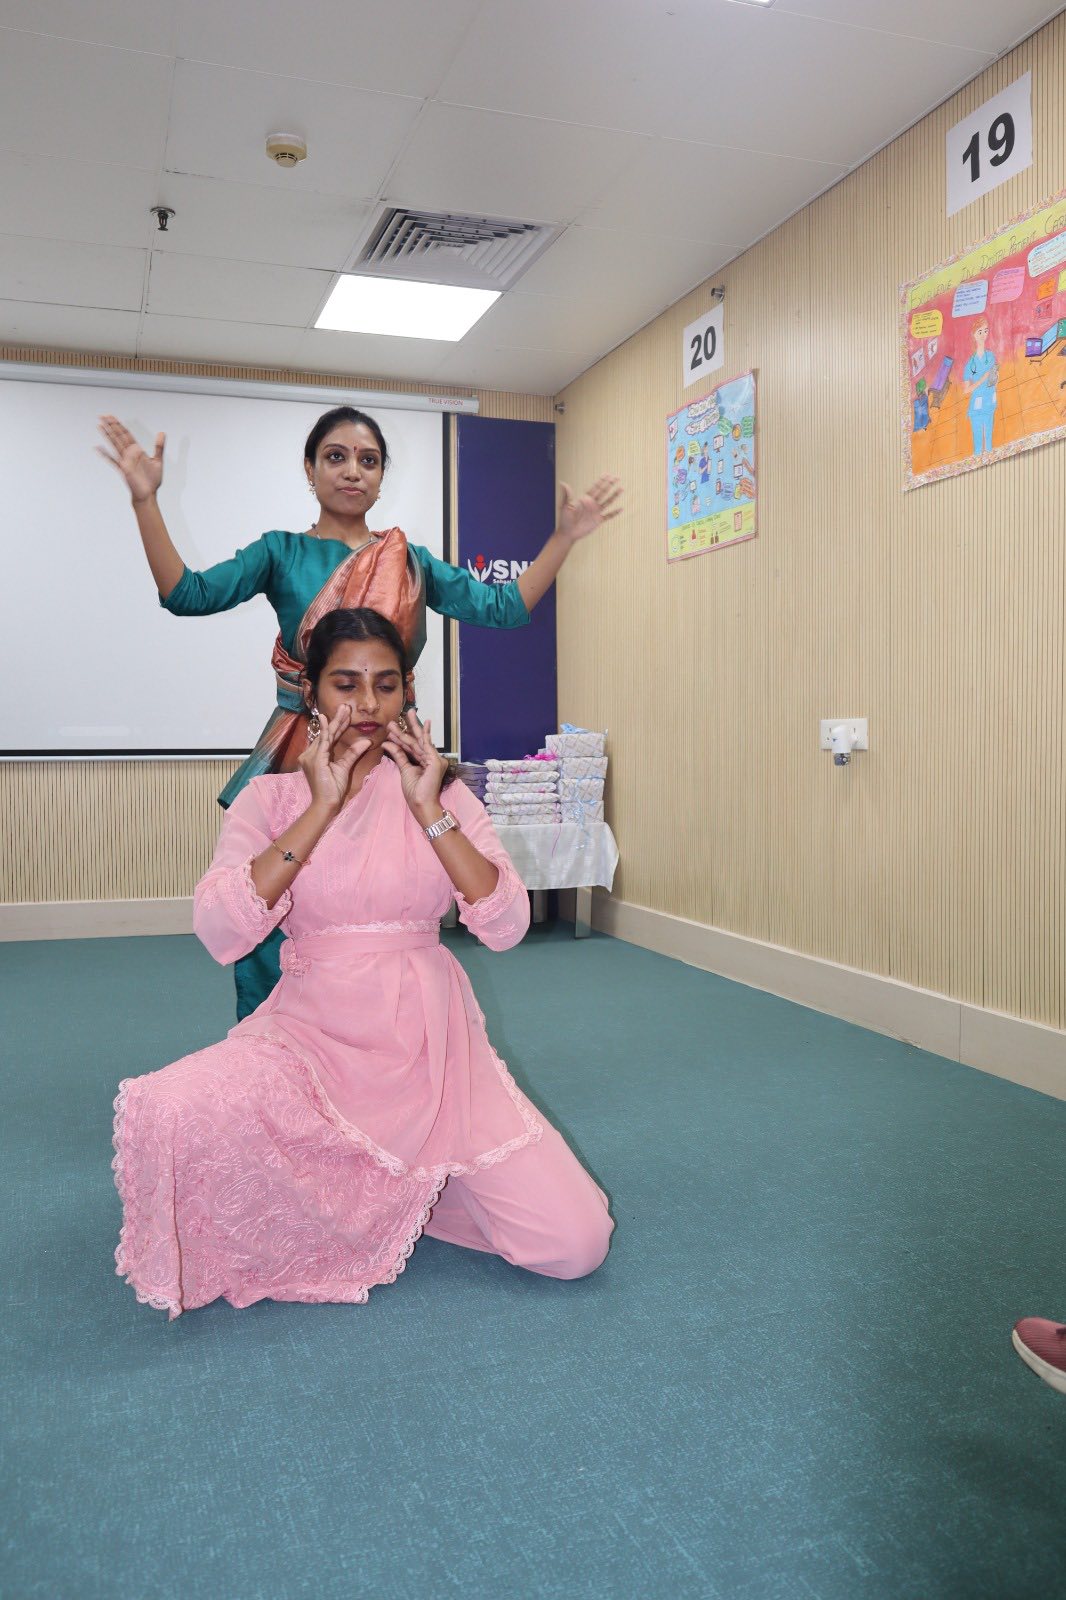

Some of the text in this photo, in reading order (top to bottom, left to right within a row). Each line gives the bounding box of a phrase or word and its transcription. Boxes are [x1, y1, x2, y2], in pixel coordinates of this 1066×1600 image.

[962, 112, 1015, 182] 19
[691, 326, 716, 370] 20
[493, 559, 534, 580] SN
